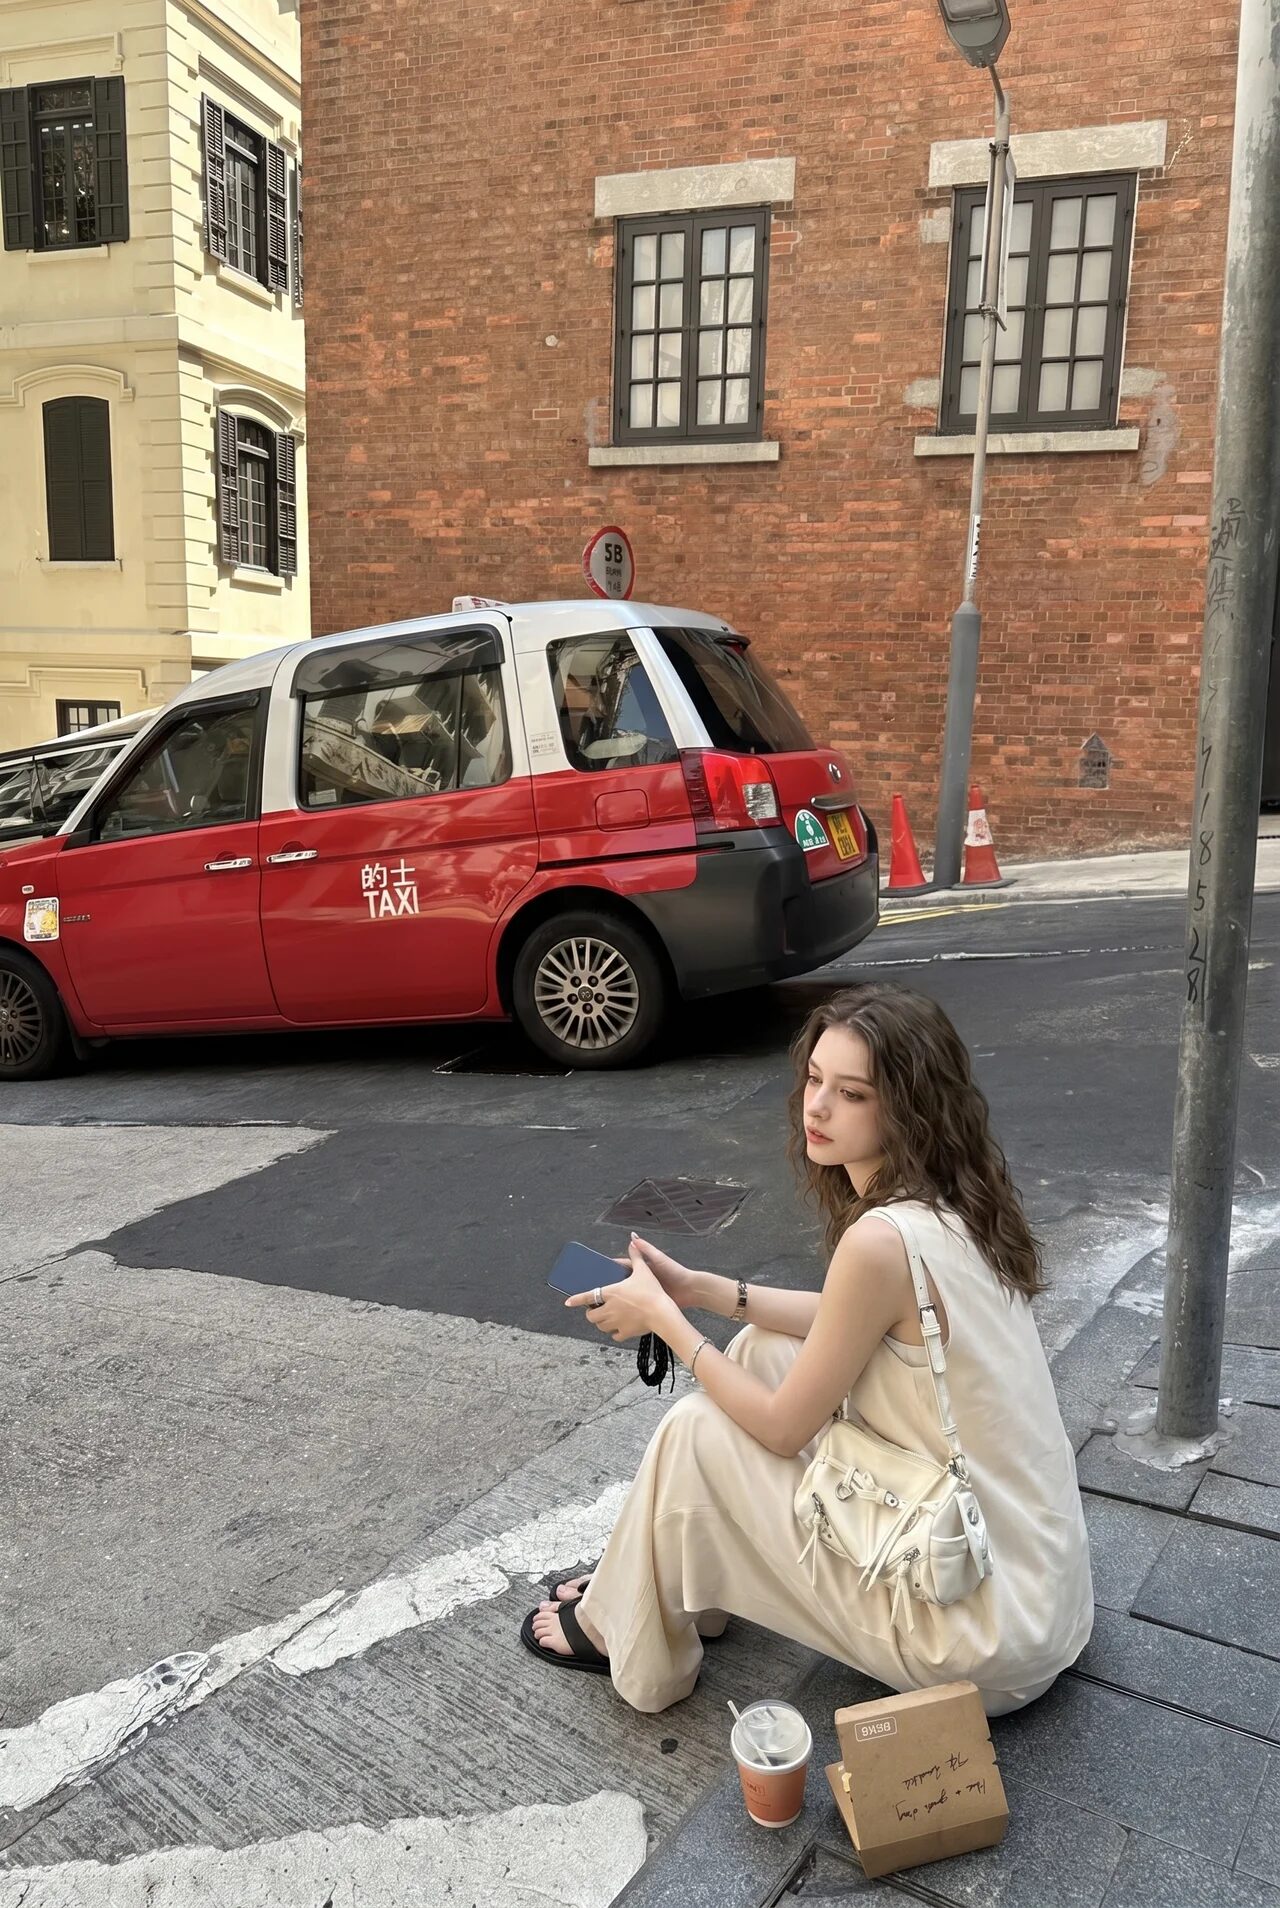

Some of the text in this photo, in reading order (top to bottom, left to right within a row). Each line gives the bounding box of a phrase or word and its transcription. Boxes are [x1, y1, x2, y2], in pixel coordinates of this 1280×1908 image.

[604, 542, 623, 563] 5B
[361, 858, 416, 889] 的士
[363, 886, 420, 918] TAXI
